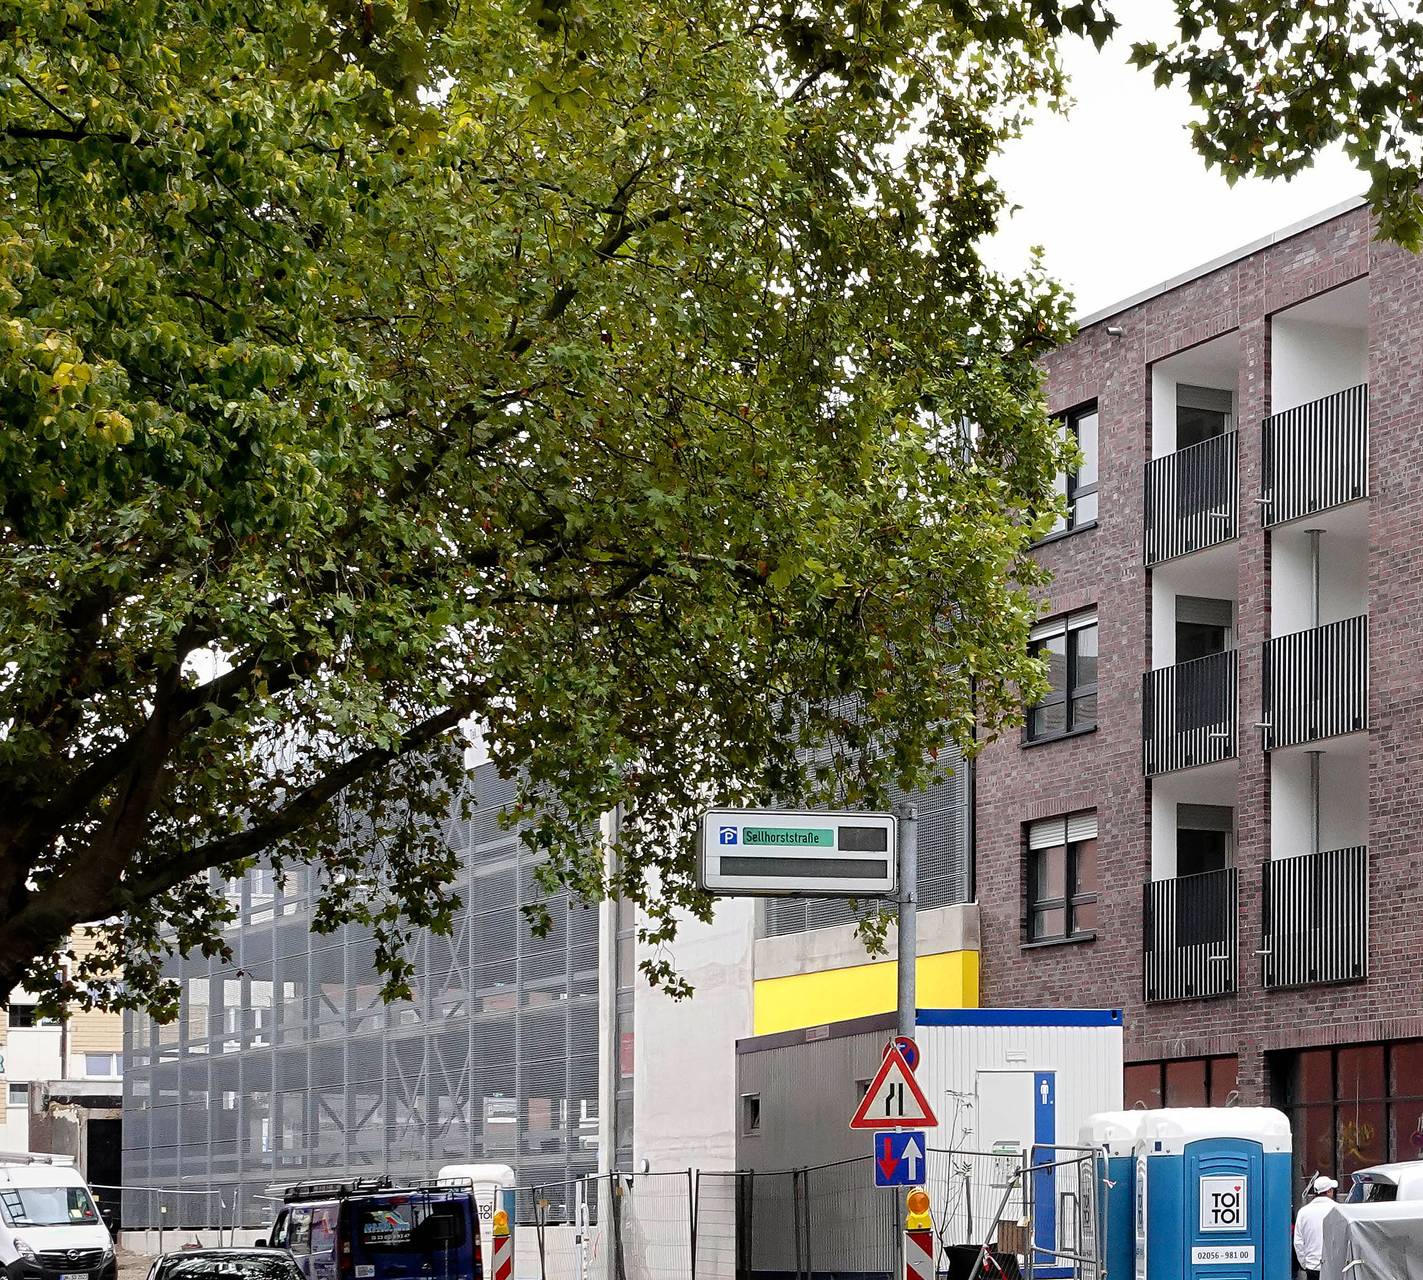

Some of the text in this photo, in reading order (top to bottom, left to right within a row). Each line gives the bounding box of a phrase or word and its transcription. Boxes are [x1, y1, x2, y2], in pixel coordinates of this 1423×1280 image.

[746, 830, 820, 843] Sellhorststraße
[1211, 1192, 1240, 1208] TOI
[479, 1203, 493, 1212] TOI
[479, 1212, 493, 1220] TOI
[1211, 1208, 1240, 1224] TOI
